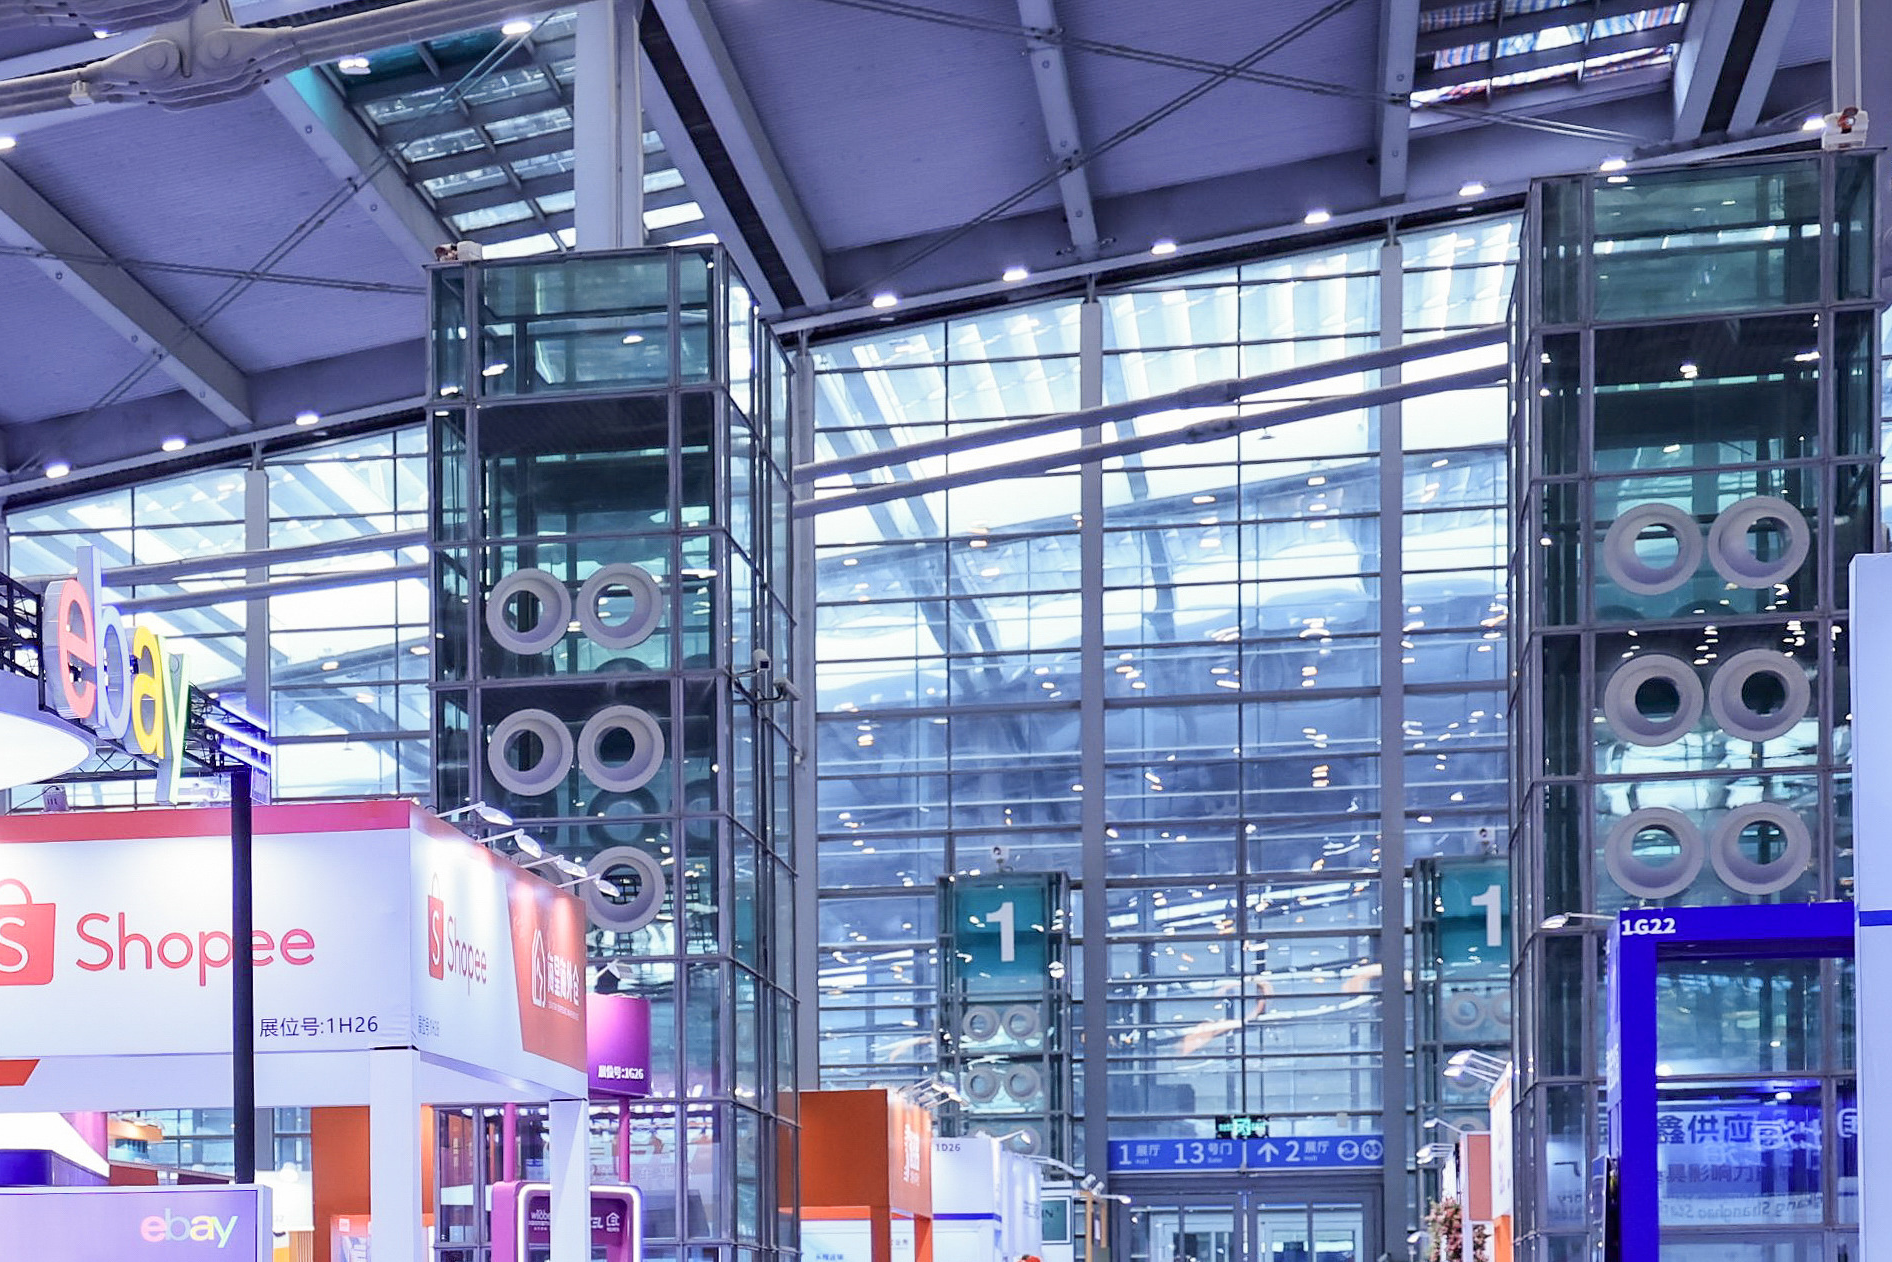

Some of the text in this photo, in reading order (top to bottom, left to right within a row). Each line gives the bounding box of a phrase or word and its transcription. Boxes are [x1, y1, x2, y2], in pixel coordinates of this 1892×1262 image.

[43, 545, 191, 805] ebay
[986, 901, 1015, 962] 1
[1471, 884, 1501, 947] 1
[1621, 917, 1676, 936] 1G22
[75, 912, 315, 986] Shopee
[447, 915, 487, 997] Shopee
[259, 1014, 379, 1038] 展位号:1H26
[936, 1143, 961, 1152] 1D26
[1119, 1140, 1330, 1165] 1 展厅 13 号门 2 展厅
[140, 1207, 238, 1248] ebay
